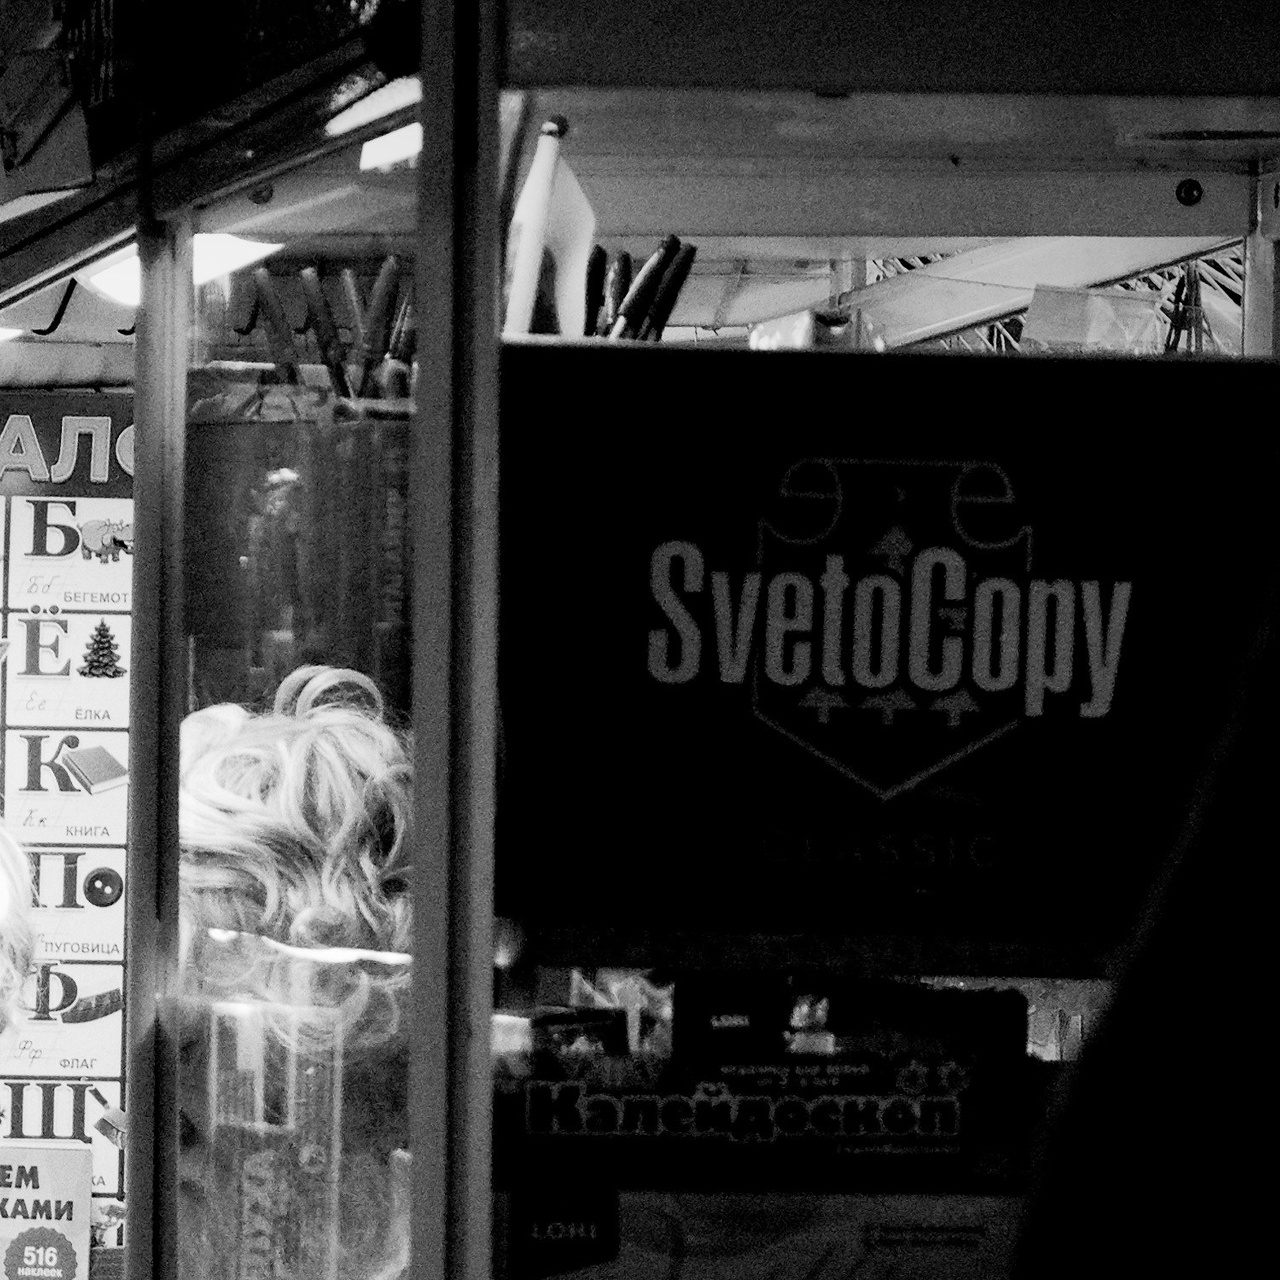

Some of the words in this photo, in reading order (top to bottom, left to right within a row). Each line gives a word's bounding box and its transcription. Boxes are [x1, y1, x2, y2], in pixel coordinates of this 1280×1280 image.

[23, 499, 81, 557] Б
[63, 590, 130, 604] БЕГЕМОТ
[16, 603, 71, 677] Ё
[646, 538, 1134, 720] SvetoCopy
[18, 735, 82, 792] К
[65, 825, 111, 838] КНИГА
[44, 942, 120, 955] ПУГОВИЦА
[59, 1058, 97, 1070] ФЛАГ
[524, 1079, 963, 1145] Калейдоскоп
[23, 1245, 58, 1267] 516
